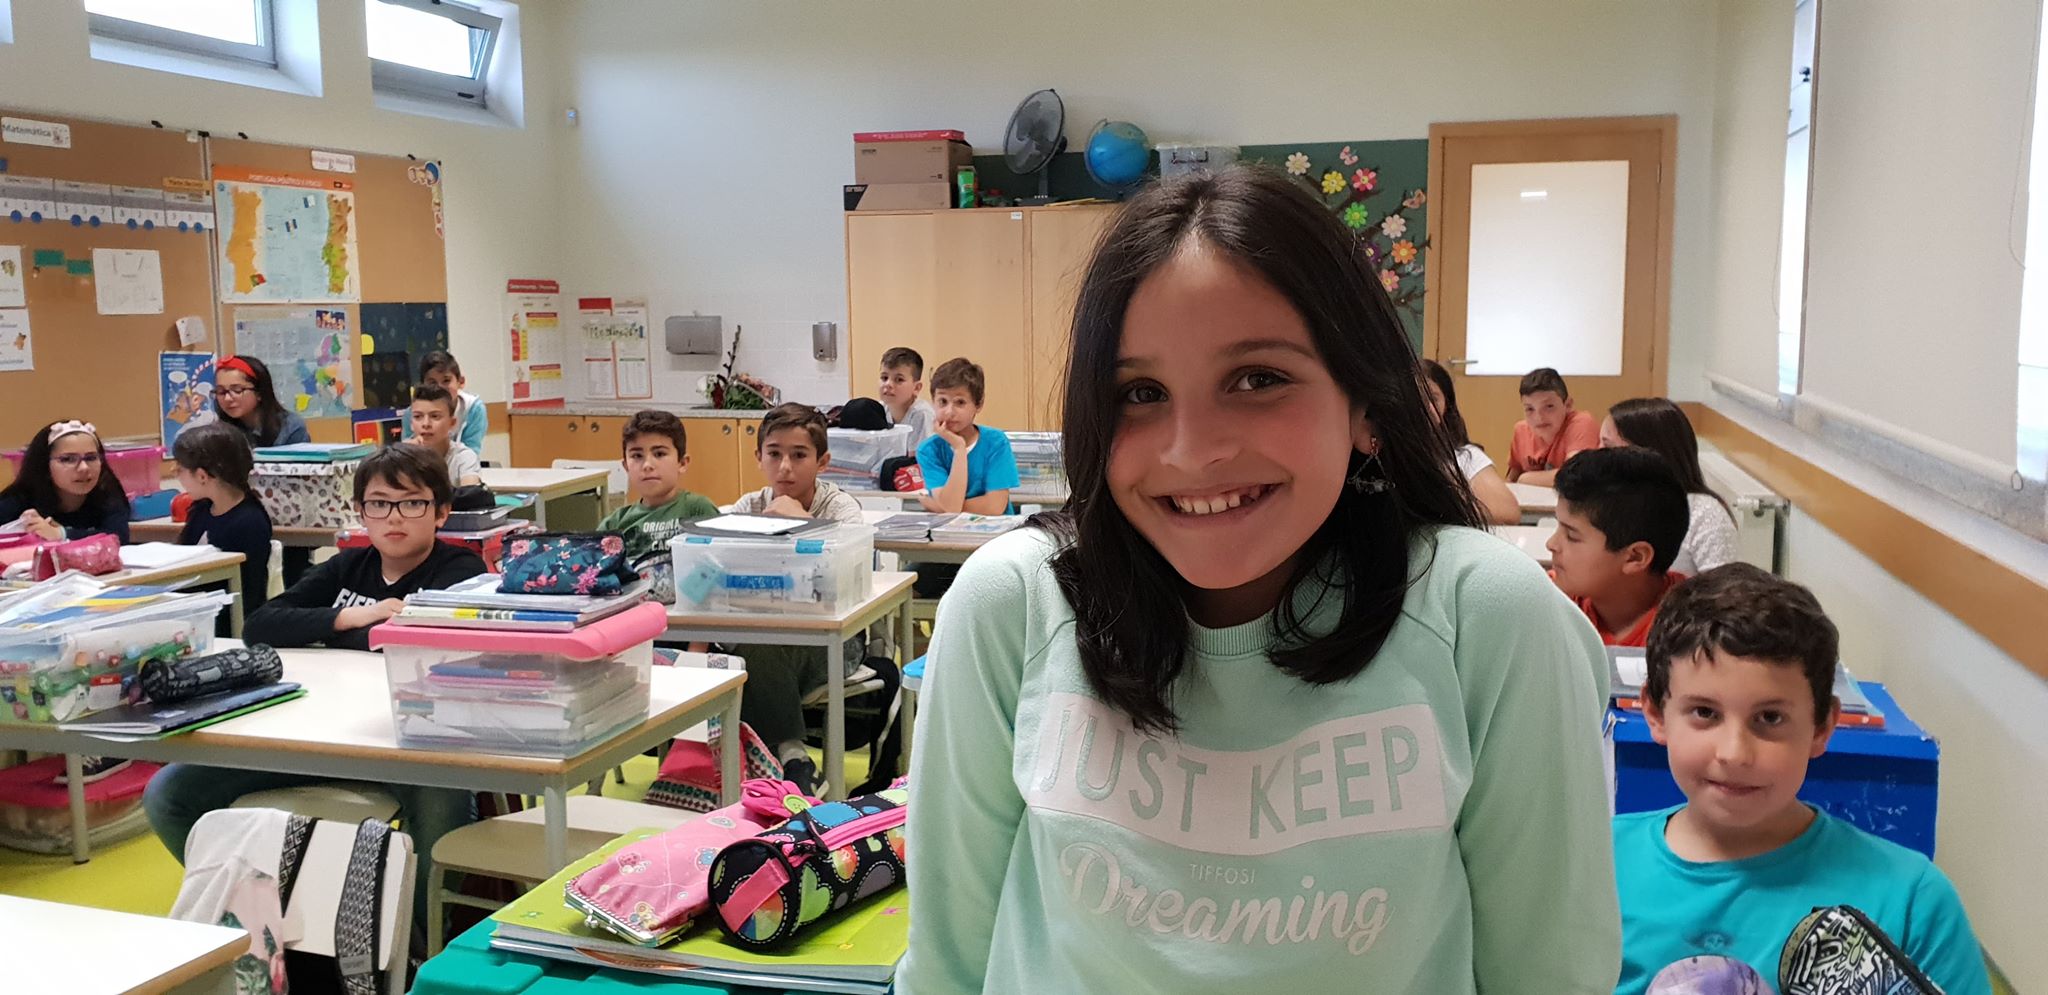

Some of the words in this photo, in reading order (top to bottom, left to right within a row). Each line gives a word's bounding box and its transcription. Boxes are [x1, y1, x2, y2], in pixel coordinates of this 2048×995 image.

[643, 518, 681, 533] ORIGINA
[1040, 709, 1208, 833] JUST
[1248, 725, 1421, 840] KEEP
[1059, 841, 1396, 956] Dreaming
[1189, 863, 1257, 885] TIFFOSI
